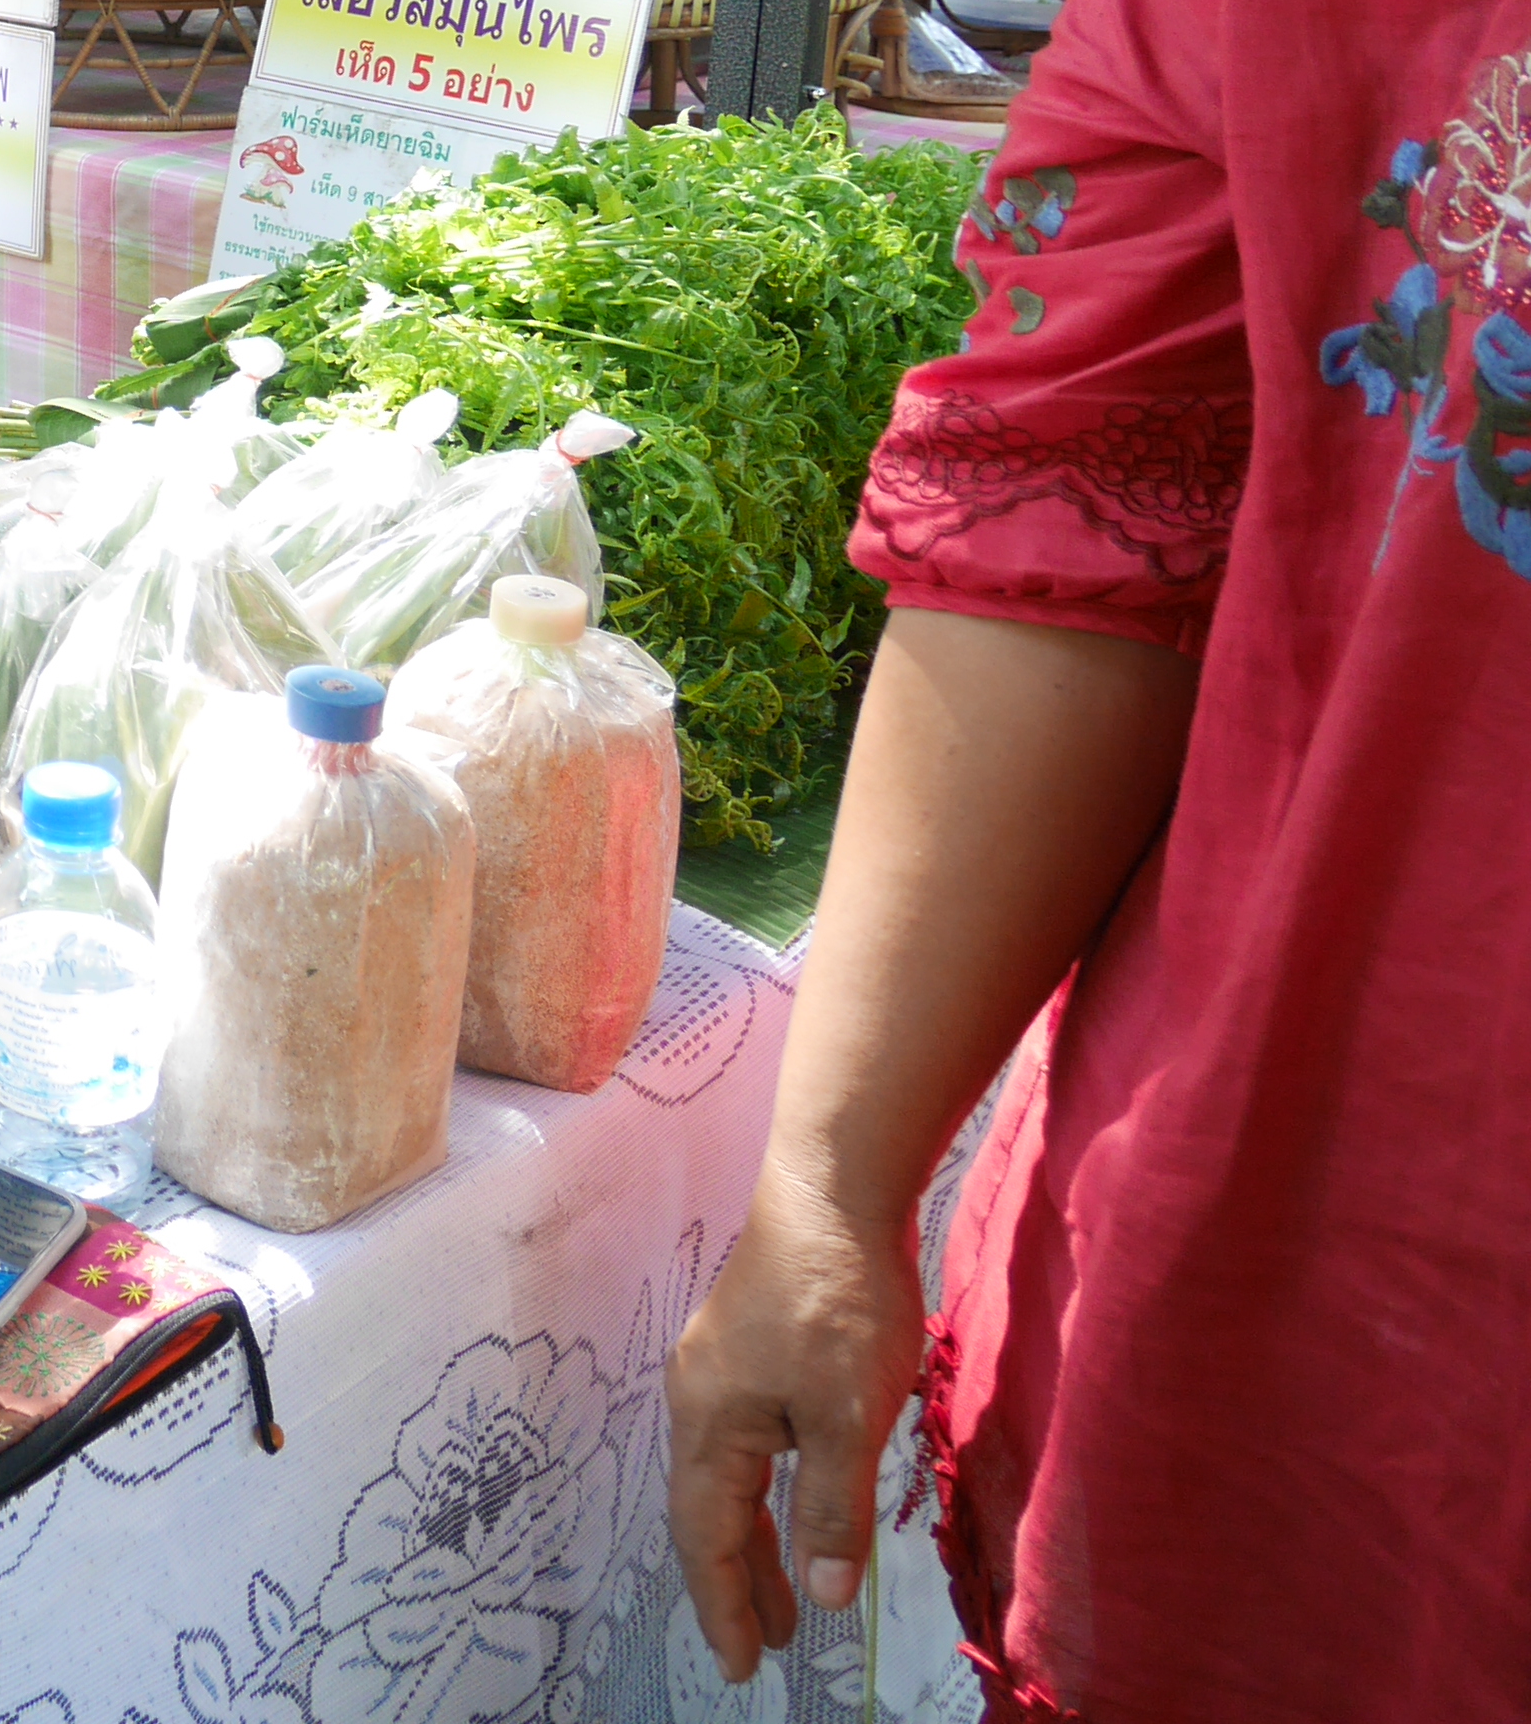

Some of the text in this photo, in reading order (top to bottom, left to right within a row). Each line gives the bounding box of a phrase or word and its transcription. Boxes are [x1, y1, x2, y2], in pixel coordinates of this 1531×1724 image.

[336, 39, 536, 113] เห็ด 5 อย่าง
[281, 105, 452, 164] ฟาร์มเห็ดยายฉิม
[310, 172, 342, 199] เห็ด
[347, 185, 358, 203] 9
